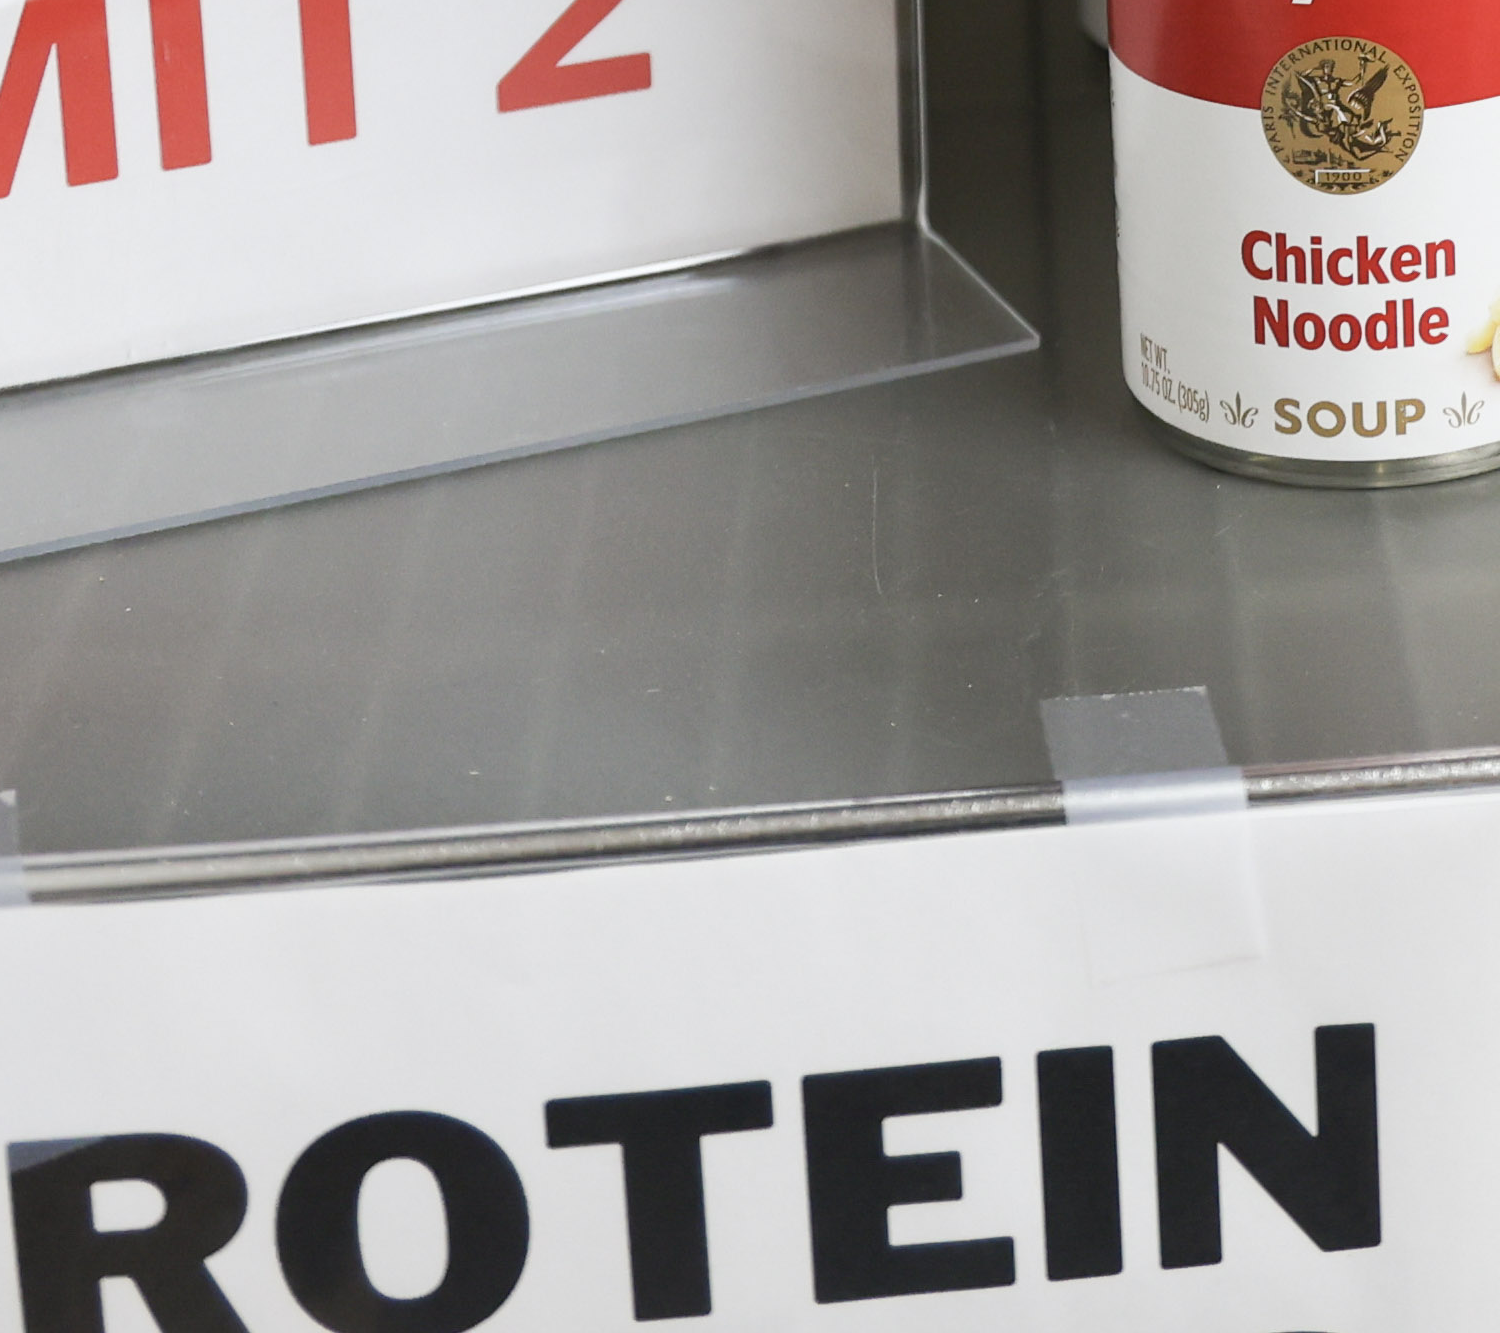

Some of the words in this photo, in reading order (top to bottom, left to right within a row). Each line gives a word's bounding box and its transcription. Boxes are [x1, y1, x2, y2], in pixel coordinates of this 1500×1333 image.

[1265, 39, 1387, 96] INTERNATIONAL
[1263, 106, 1283, 153] PARIS
[1393, 65, 1421, 162] EXPOSITION
[1326, 172, 1362, 182] 1900
[1240, 229, 1456, 287] Chicken
[1252, 296, 1450, 352] Noodle
[1274, 397, 1425, 437] SOUP
